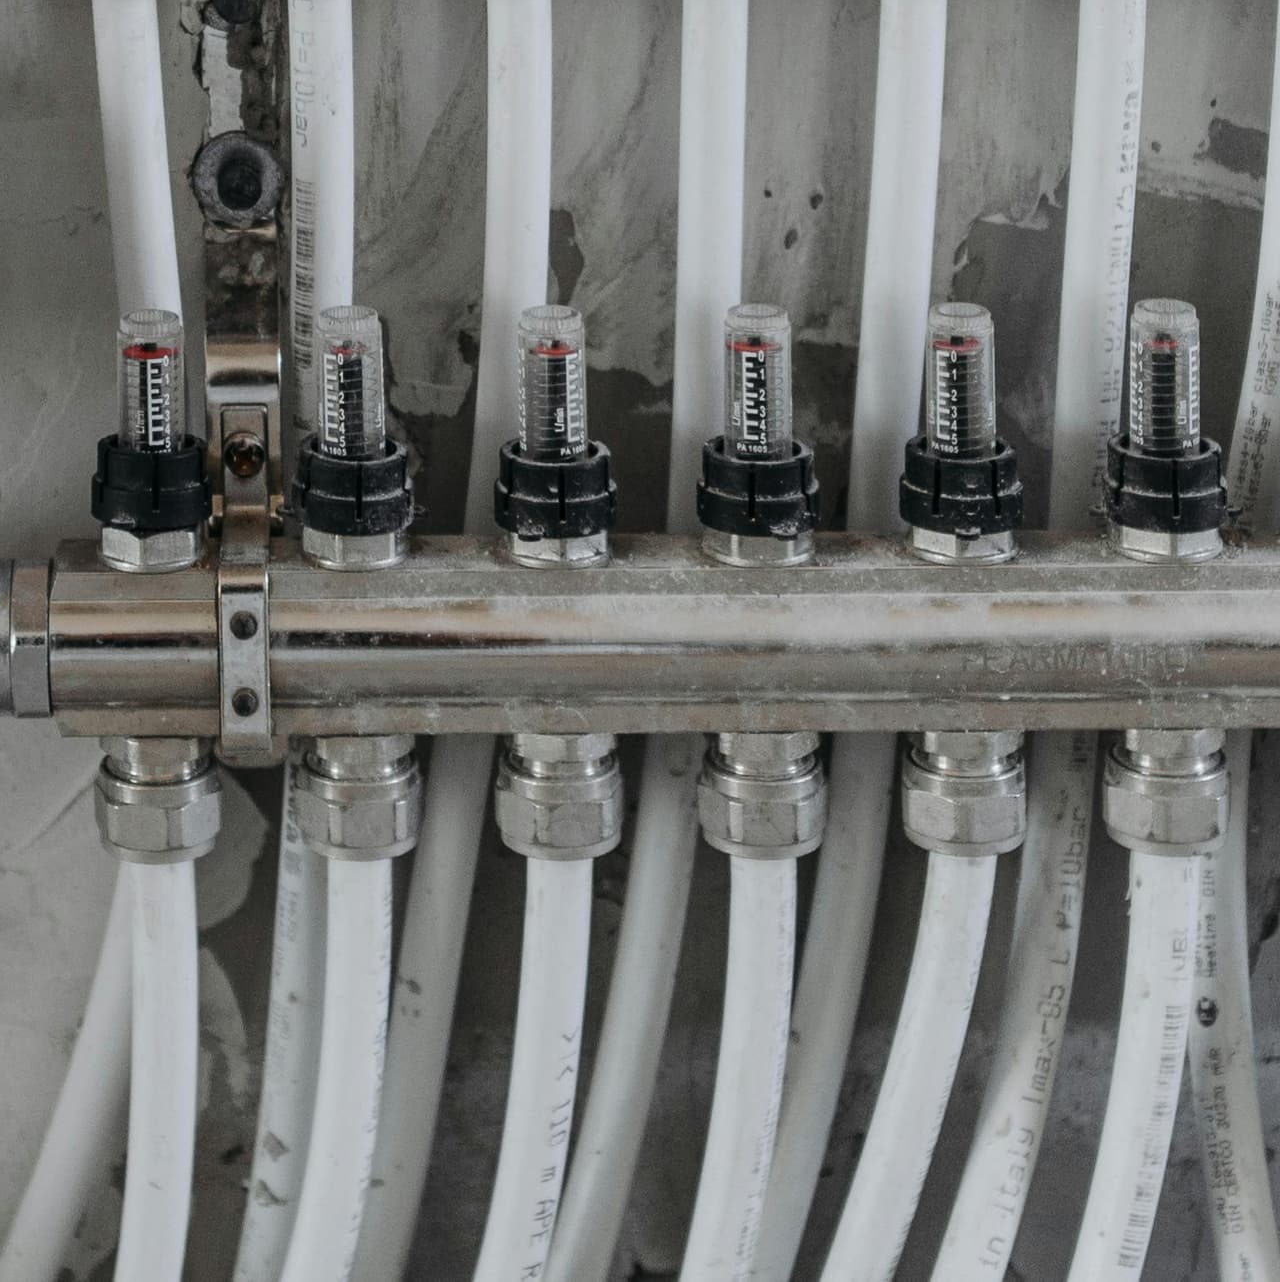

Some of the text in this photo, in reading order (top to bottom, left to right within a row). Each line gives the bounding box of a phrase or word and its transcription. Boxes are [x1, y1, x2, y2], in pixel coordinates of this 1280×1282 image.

[337, 353, 344, 365] 0
[758, 350, 764, 362] 0
[951, 350, 957, 362] 0
[339, 372, 344, 383] 1
[760, 368, 764, 380] 1
[952, 369, 957, 380] 1
[338, 391, 345, 404] 2
[759, 389, 765, 401] 2
[951, 389, 957, 401] 2
[339, 409, 345, 420] 3
[759, 406, 765, 417] 3
[951, 406, 957, 418] 3
[339, 422, 345, 434] 4
[760, 419, 766, 431] 4
[951, 420, 957, 431] 4
[339, 436, 345, 448] 5
[760, 433, 766, 444] 5
[952, 433, 957, 445] 5
